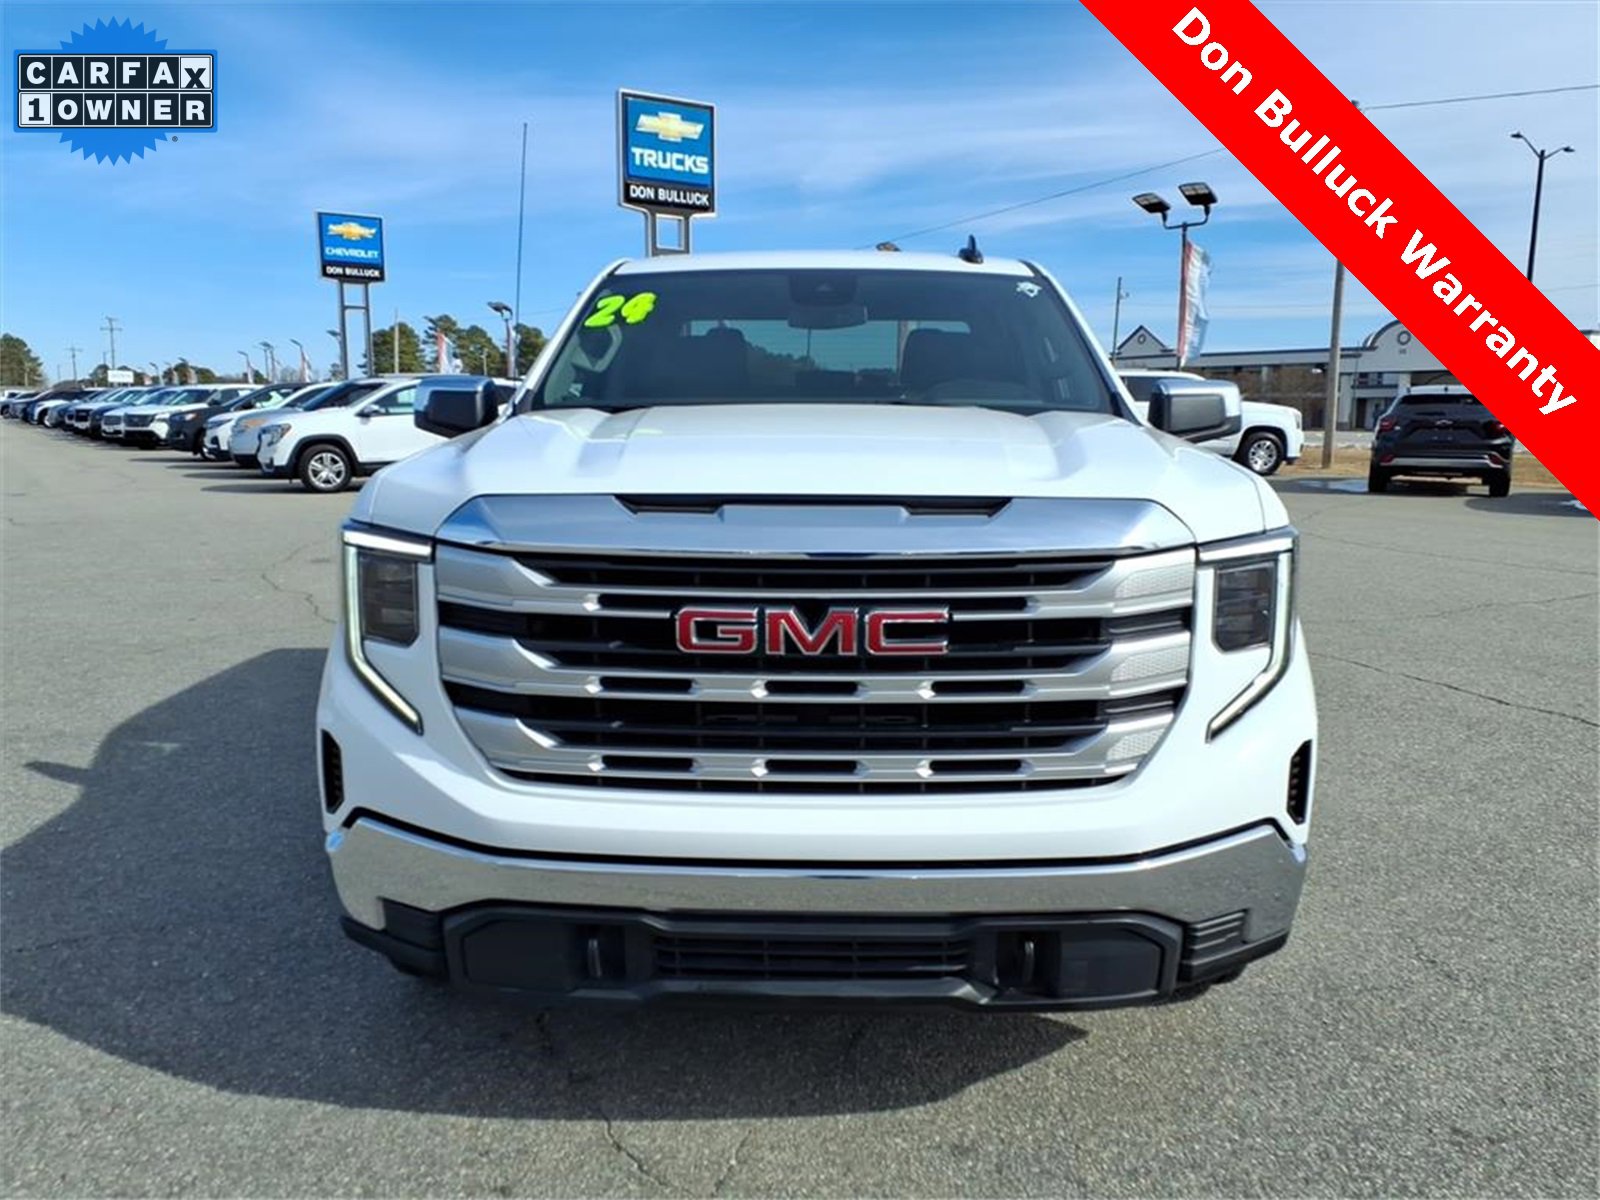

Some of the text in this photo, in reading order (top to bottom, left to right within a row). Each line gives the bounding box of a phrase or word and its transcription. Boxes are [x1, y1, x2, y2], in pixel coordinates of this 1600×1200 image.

[630, 146, 709, 175] TRUCKS
[629, 184, 710, 206] DON BULLUCK
[325, 246, 379, 259] CHEVROLET
[326, 265, 343, 275] DON
[584, 291, 657, 328] 24
[675, 606, 950, 656] GMC
